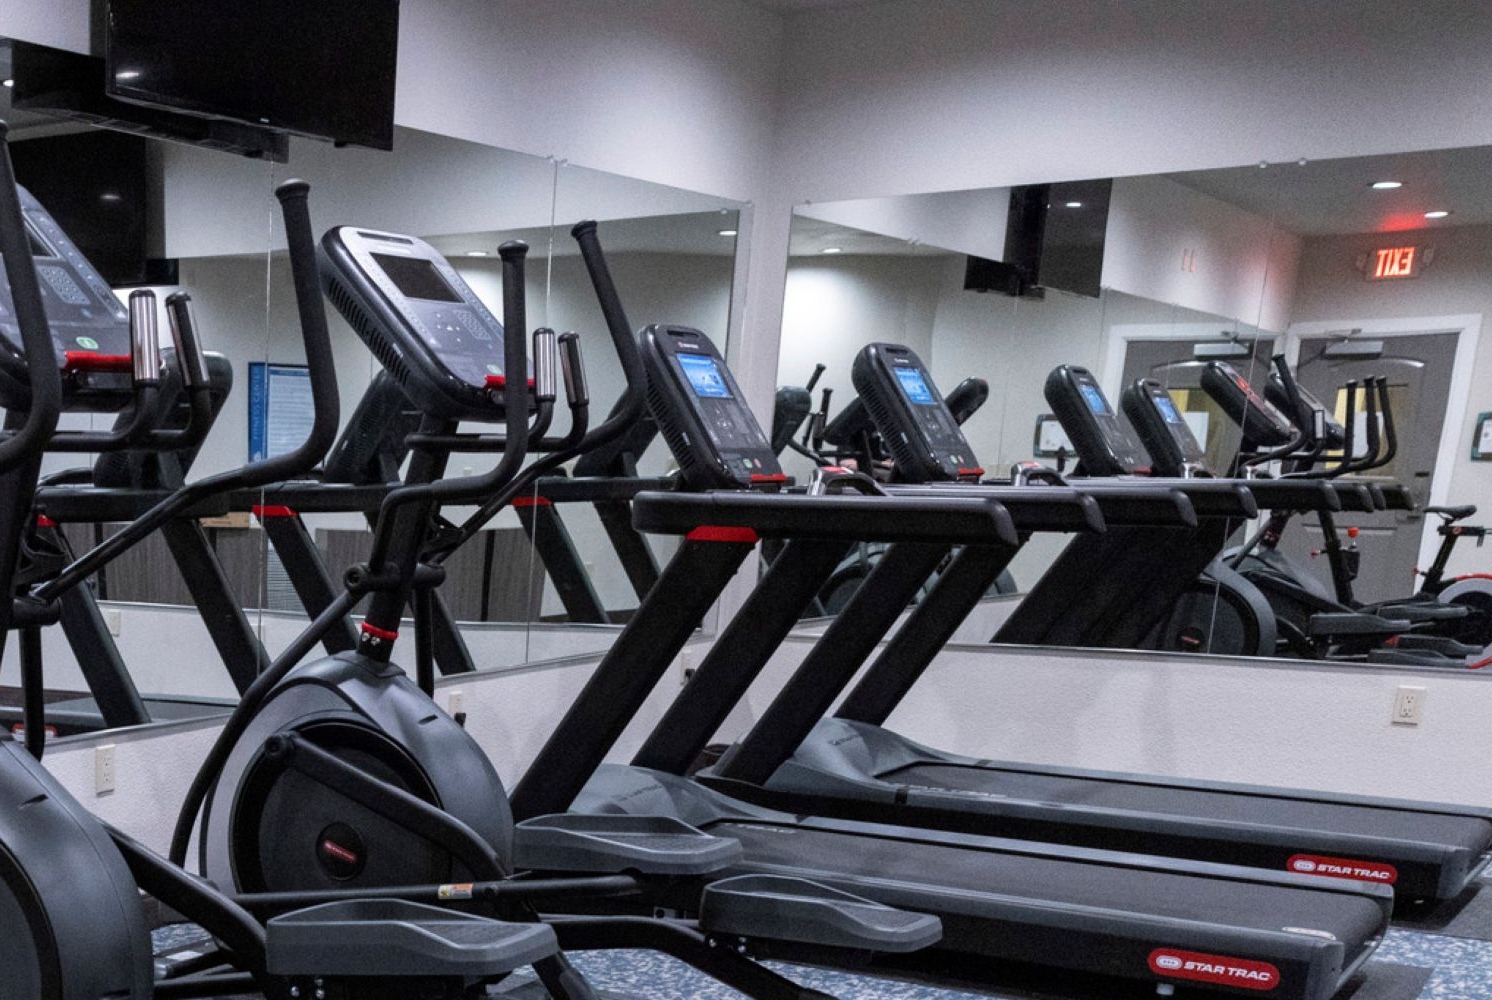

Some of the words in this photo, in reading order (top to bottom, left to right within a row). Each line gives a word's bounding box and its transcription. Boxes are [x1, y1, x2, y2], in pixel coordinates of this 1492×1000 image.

[1316, 864, 1352, 875] STAR
[1353, 868, 1390, 880] TRAC
[1183, 961, 1225, 975] STAR
[1227, 967, 1271, 981] TRAC
